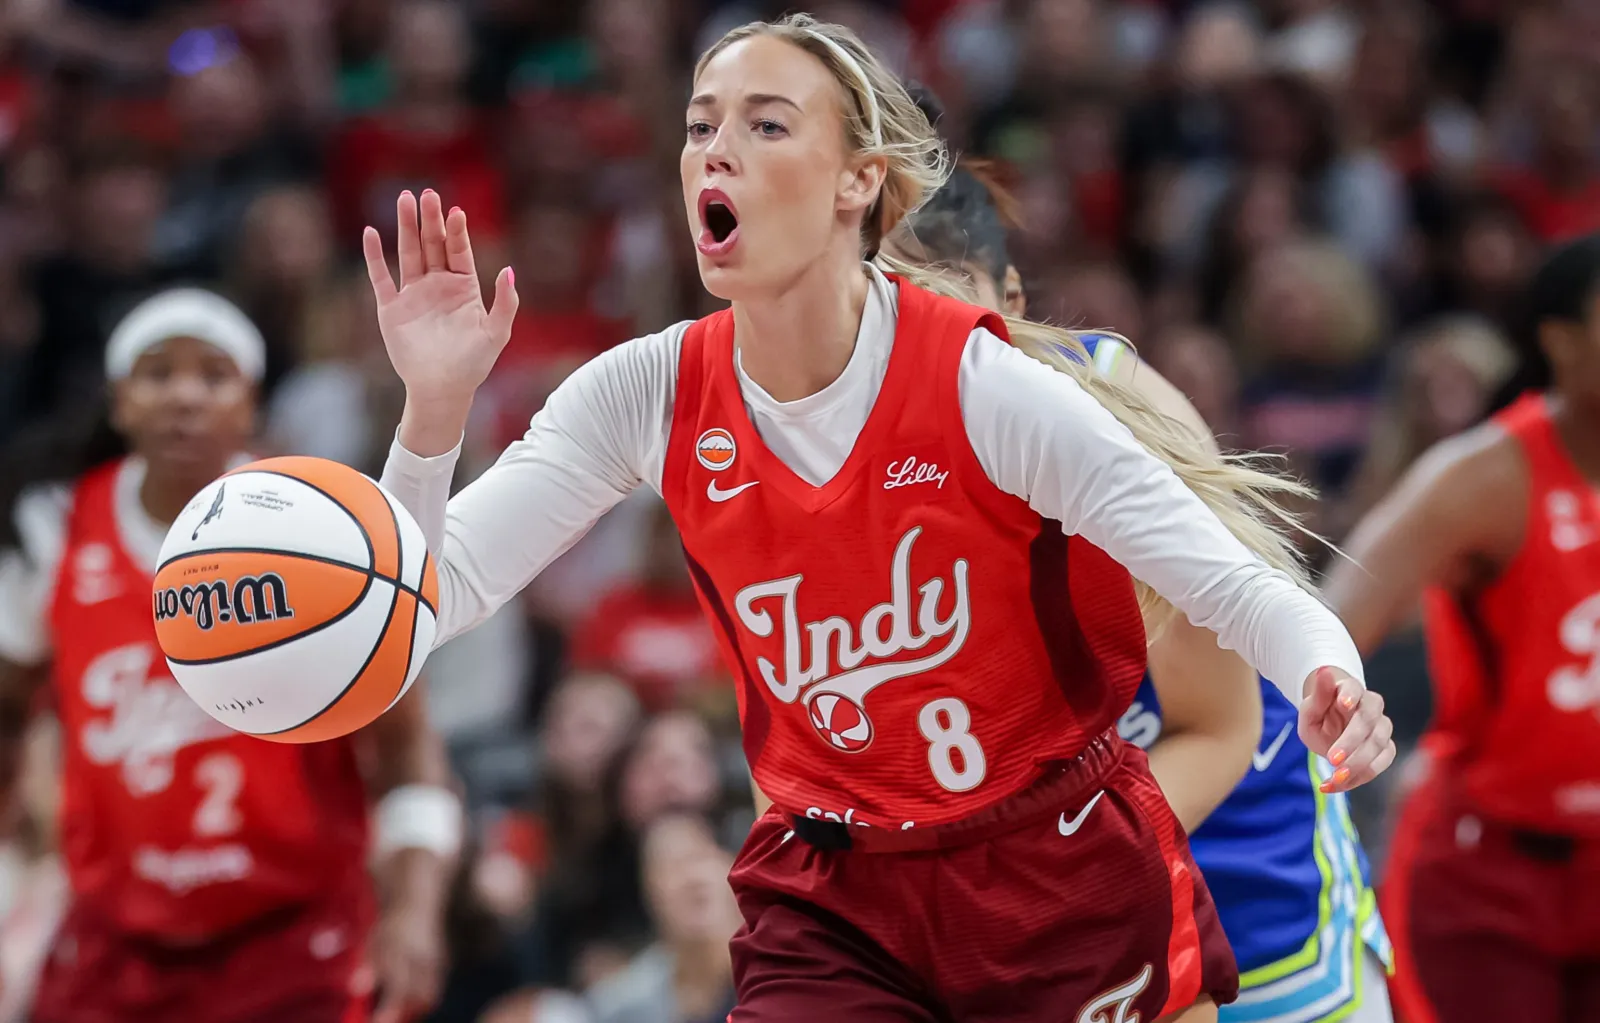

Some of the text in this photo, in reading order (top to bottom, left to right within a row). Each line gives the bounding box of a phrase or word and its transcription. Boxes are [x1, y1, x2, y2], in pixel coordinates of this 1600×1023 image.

[883, 456, 949, 489] Lilly
[154, 572, 294, 632] Wilson
[734, 525, 972, 706] Indy
[917, 697, 987, 792] 8
[193, 753, 244, 836] 2
